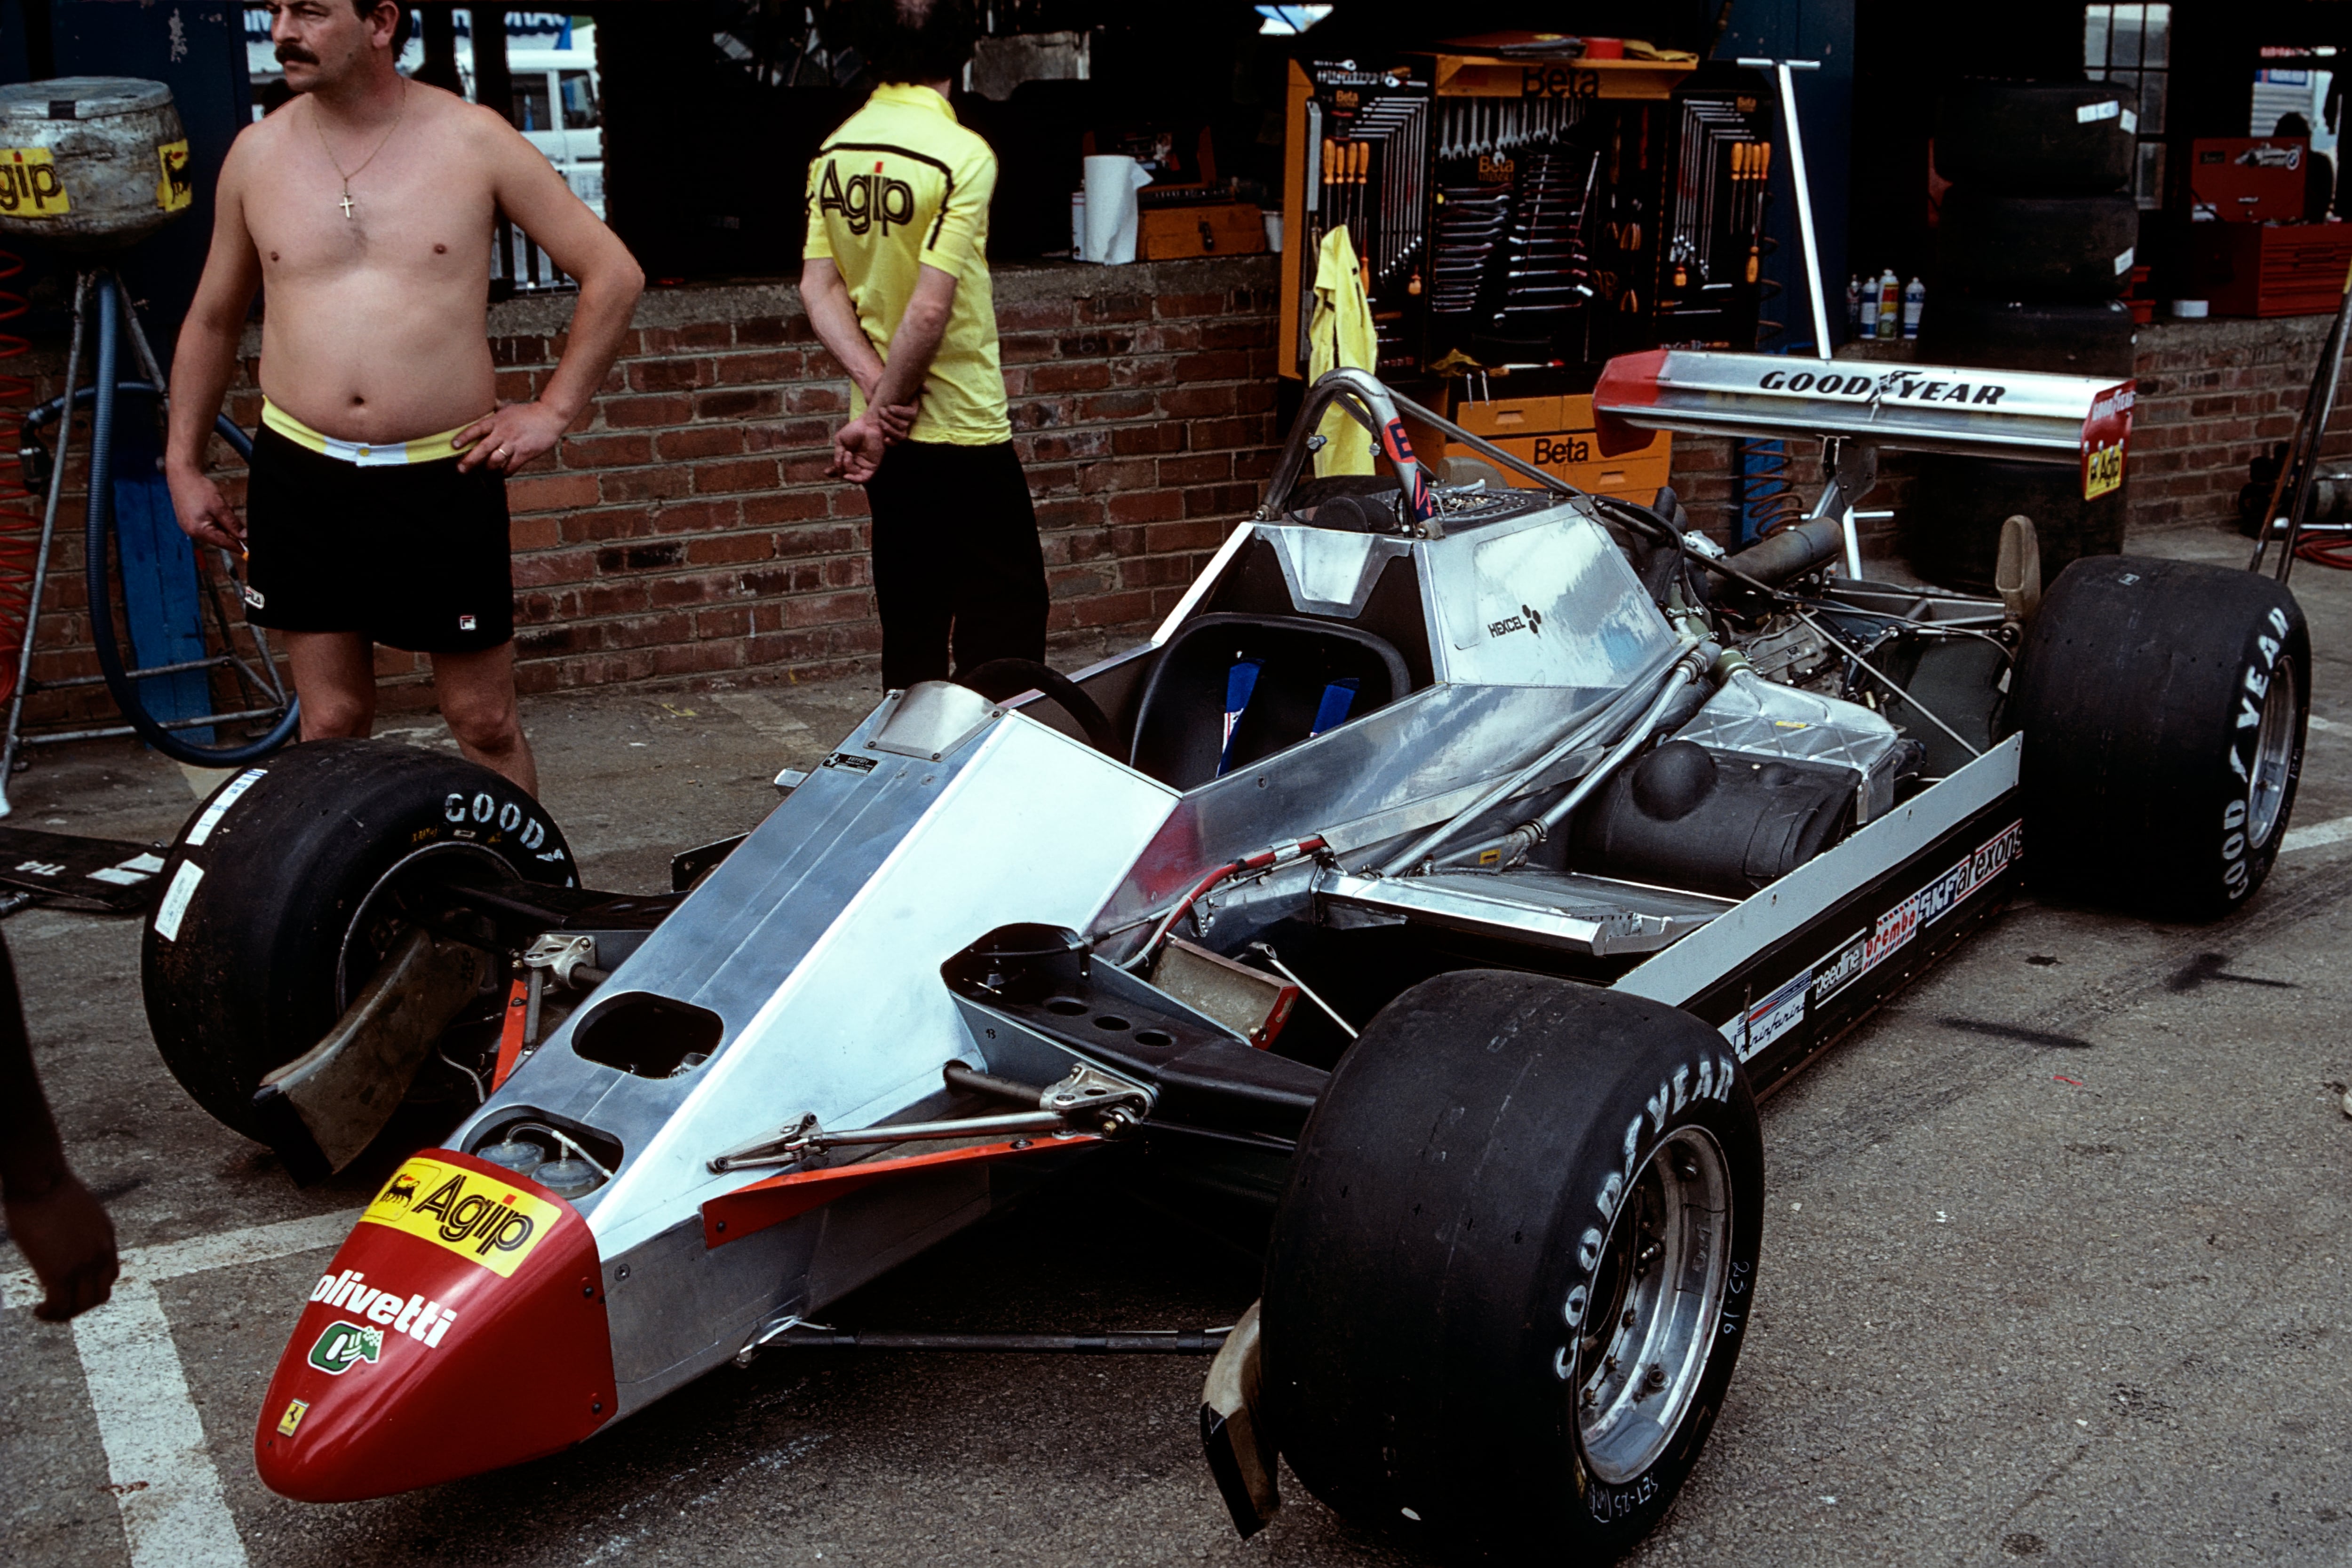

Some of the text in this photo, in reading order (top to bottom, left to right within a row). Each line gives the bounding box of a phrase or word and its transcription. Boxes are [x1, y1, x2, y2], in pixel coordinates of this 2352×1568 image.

[1522, 67, 1599, 98] Beta
[819, 158, 914, 237] Agip
[1760, 371, 2006, 405] GOOD YEAR
[1534, 437, 1589, 465] Beta
[1487, 616, 1526, 638] HEXCEL
[2236, 607, 2290, 729] YEAR
[444, 791, 546, 851] GOOD
[2222, 799, 2249, 900] GOOD
[1918, 873, 1958, 920] SKF
[1646, 1055, 1734, 1133] YEAR
[411, 1174, 535, 1256] Agip
[310, 1269, 458, 1349] olivetti
[1553, 1173, 1623, 1381] GOOD
